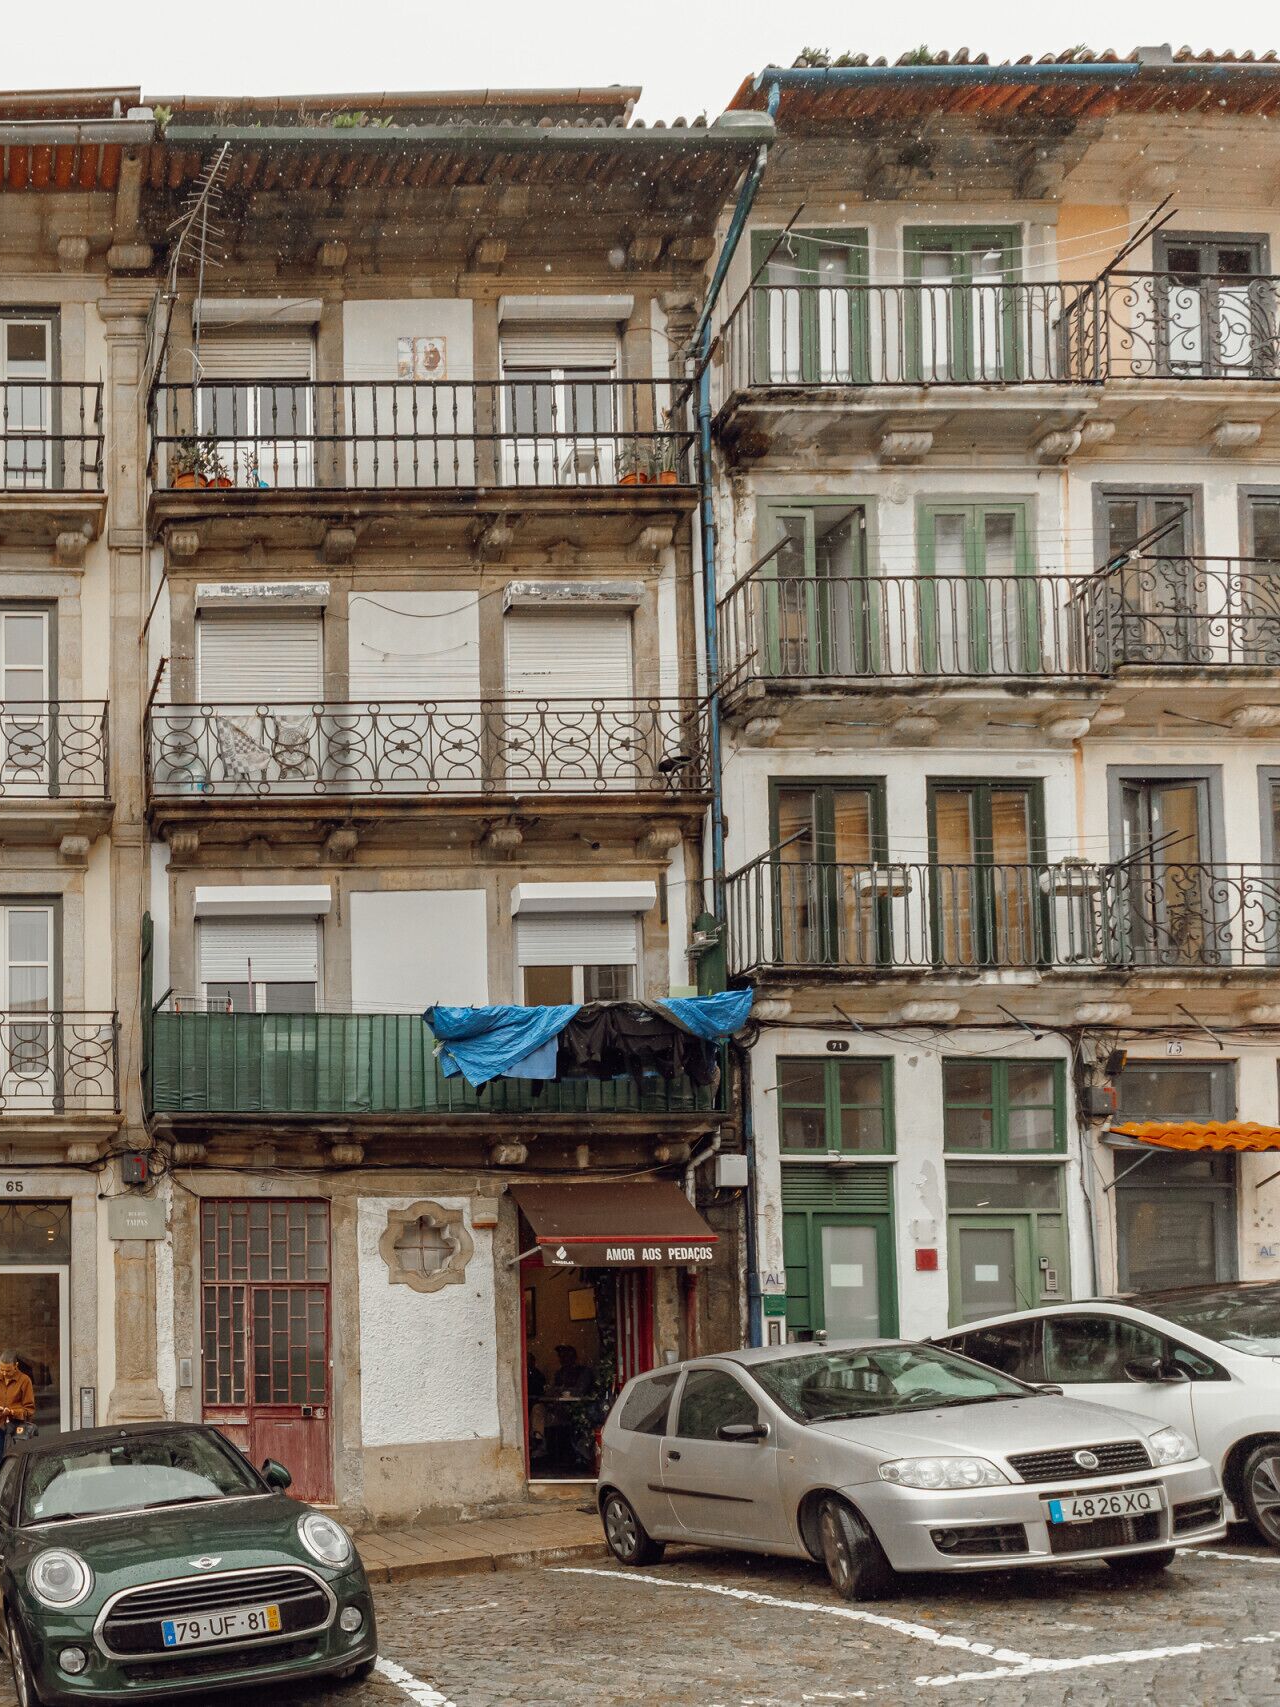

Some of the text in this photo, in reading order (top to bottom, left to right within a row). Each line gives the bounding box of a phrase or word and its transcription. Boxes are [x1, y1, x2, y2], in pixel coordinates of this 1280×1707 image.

[831, 1042, 842, 1050] 71
[1168, 1041, 1182, 1053] 75
[6, 1181, 24, 1192] 65
[606, 1247, 713, 1262] AMOR AOS PEDAÇOS
[1260, 1246, 1276, 1256] AL
[765, 1273, 785, 1285] AL
